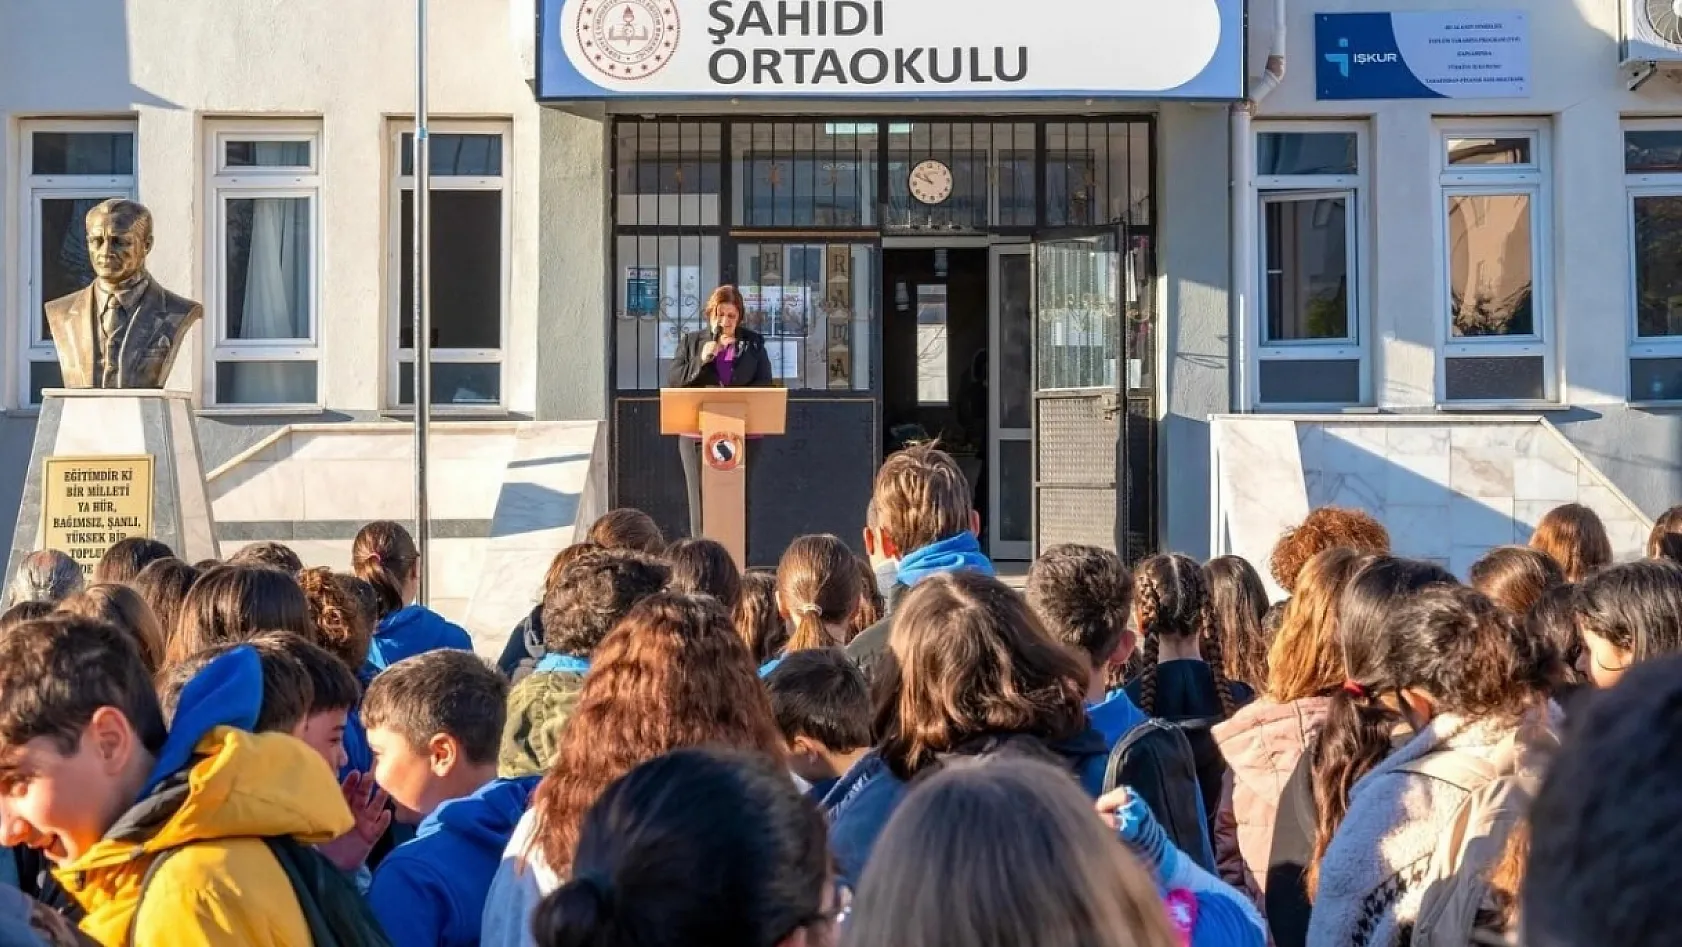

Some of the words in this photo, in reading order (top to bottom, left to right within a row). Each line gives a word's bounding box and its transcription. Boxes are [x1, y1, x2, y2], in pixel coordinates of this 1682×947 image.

[708, 46, 1028, 85] ORTAOKULU
[64, 468, 118, 482] EĞİTİMDİR
[121, 468, 133, 481] Kİ
[66, 484, 84, 497] BİR
[87, 483, 130, 496] MİLLETİ
[78, 502, 89, 512] YA
[92, 499, 117, 513] HÜR,
[53, 515, 104, 528] BAĞIMSIZ,
[107, 517, 141, 530] ŞANLI,
[66, 529, 106, 544] YÜKSEK
